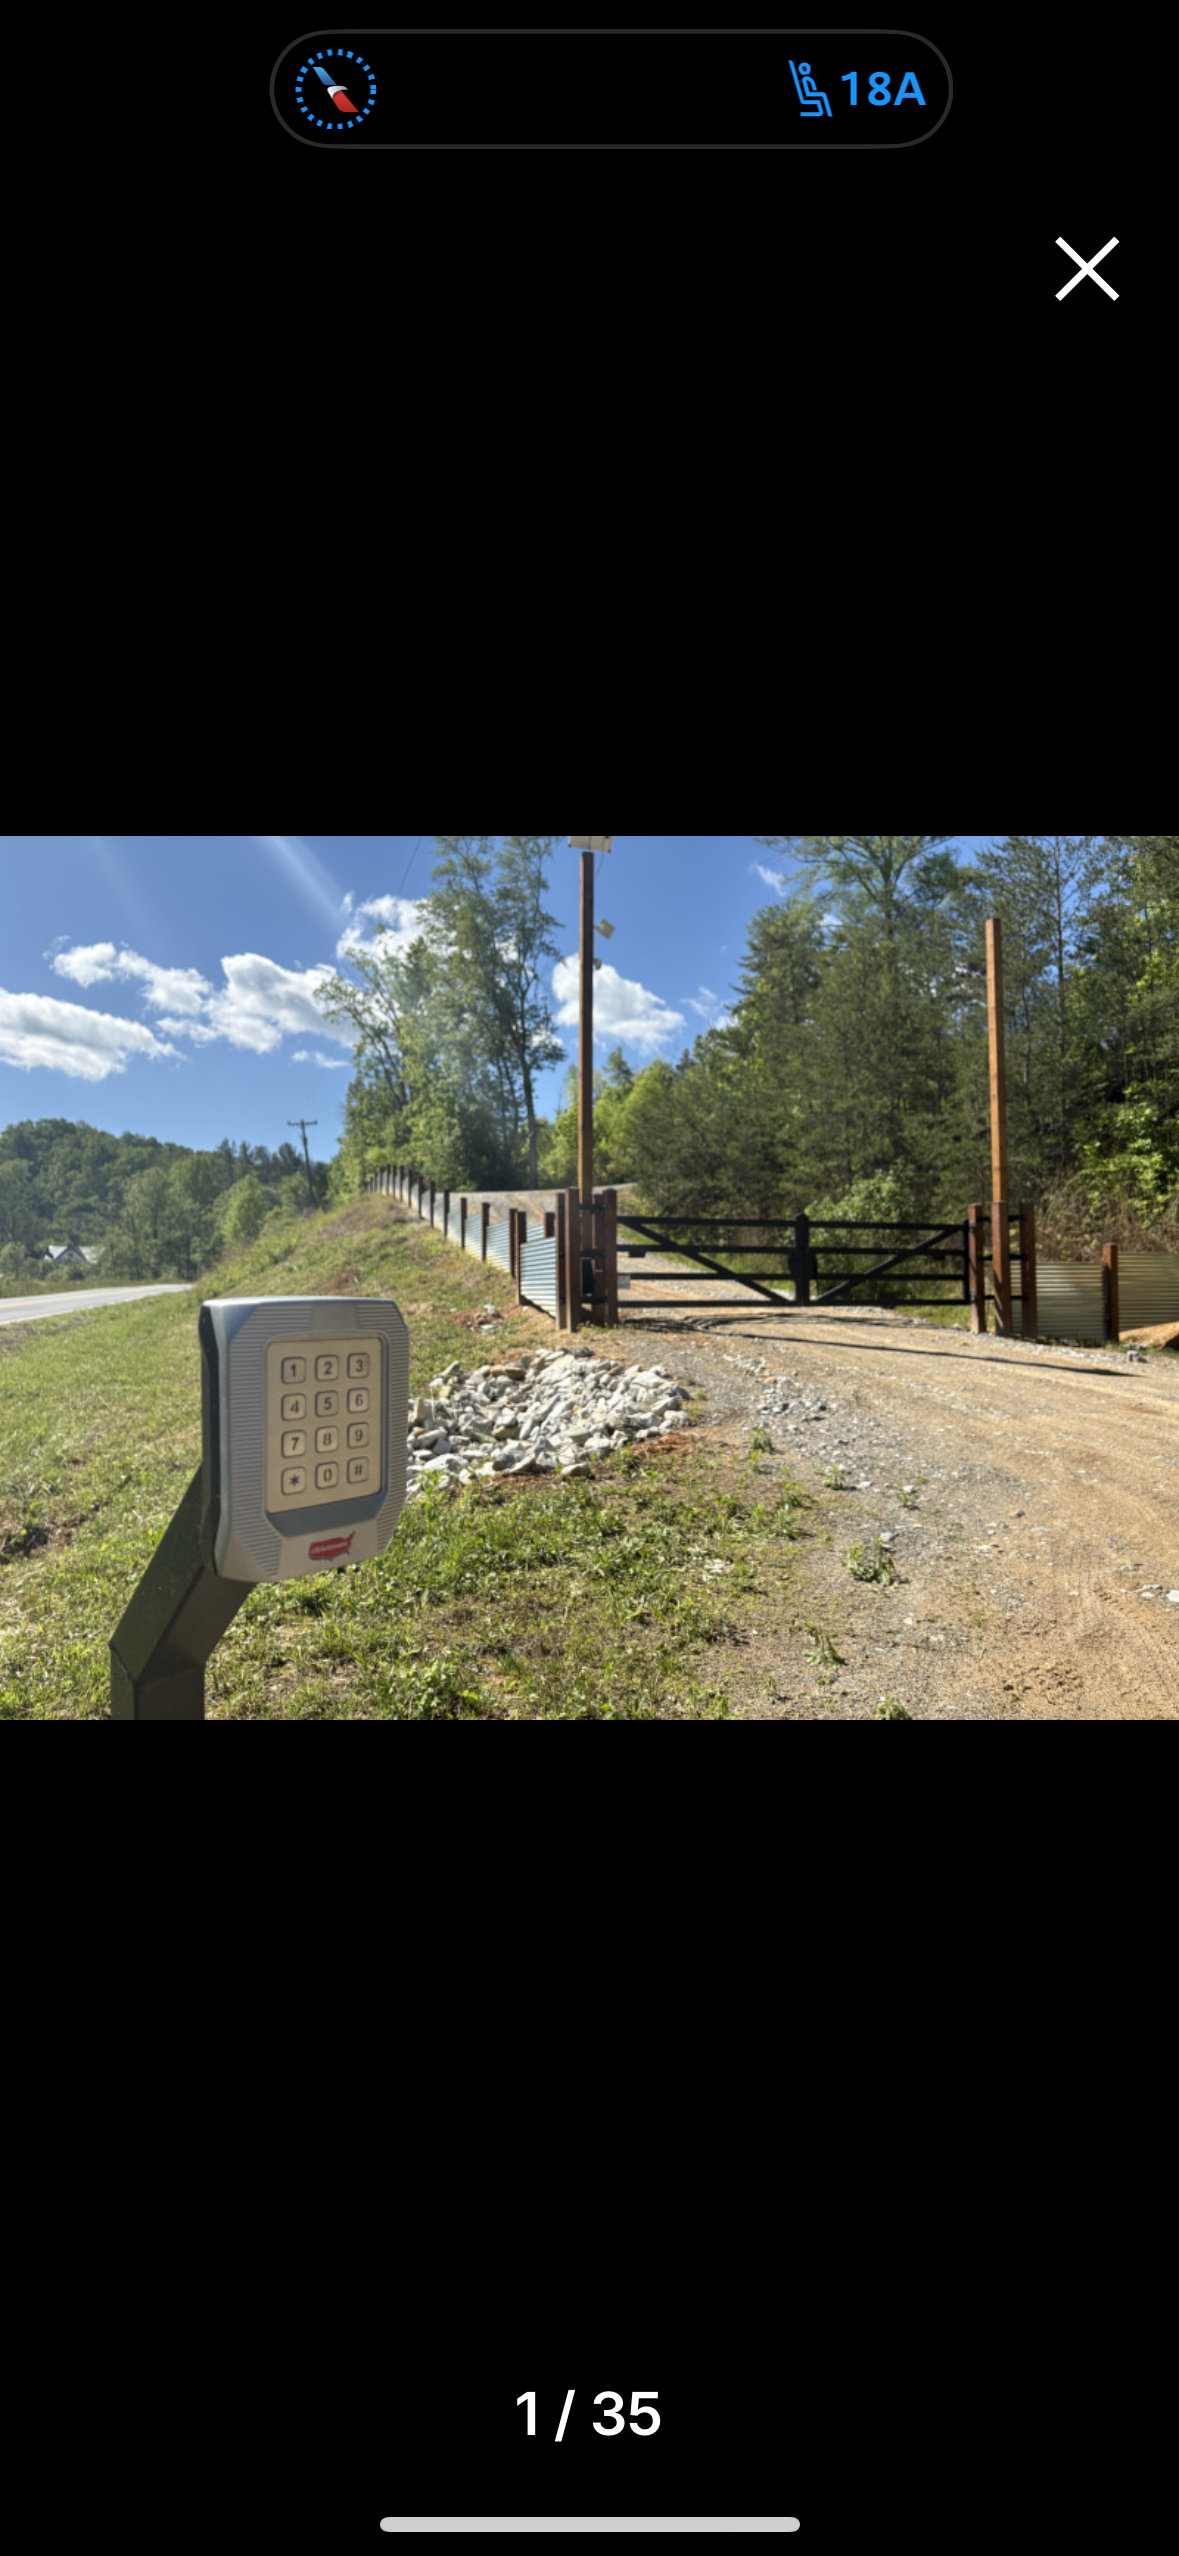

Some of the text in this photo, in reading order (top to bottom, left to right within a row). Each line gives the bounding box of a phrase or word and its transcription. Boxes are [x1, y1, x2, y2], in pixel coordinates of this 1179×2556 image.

[290, 1359, 364, 1377] 1 2 3
[290, 1393, 363, 1414] 4 5 6
[291, 1428, 363, 1451] 7 8 9
[323, 1468, 332, 1482] 0
